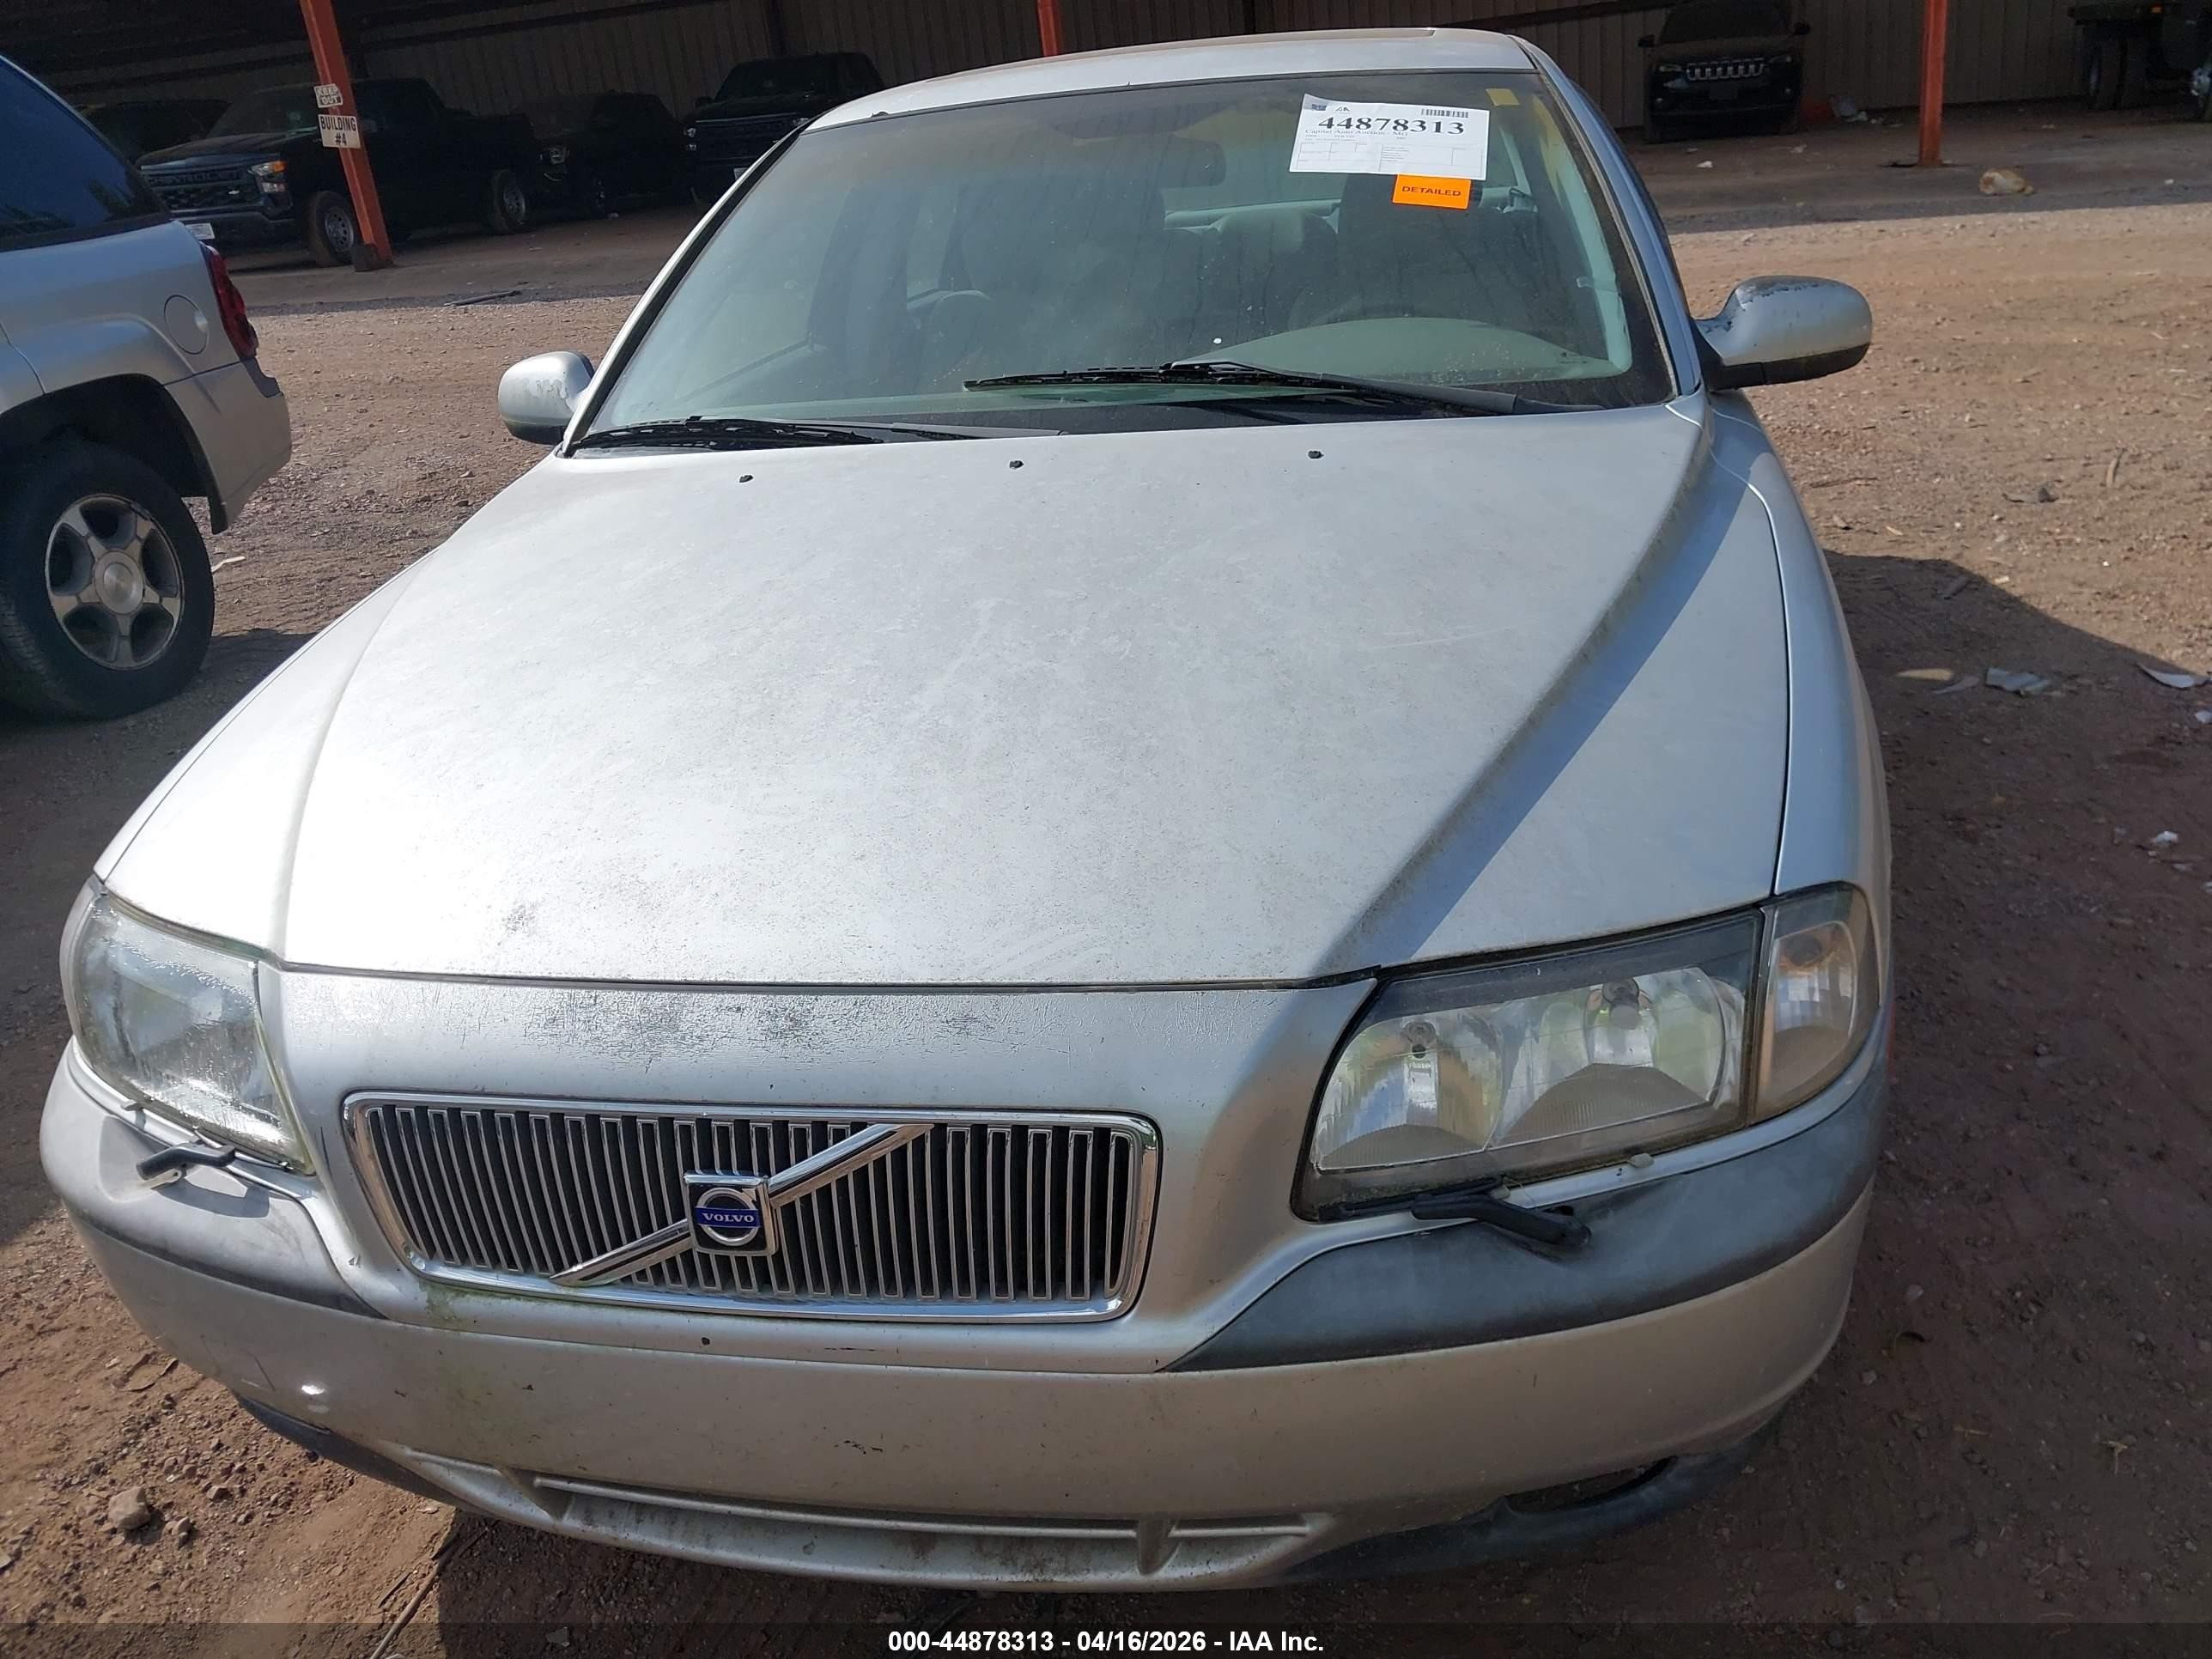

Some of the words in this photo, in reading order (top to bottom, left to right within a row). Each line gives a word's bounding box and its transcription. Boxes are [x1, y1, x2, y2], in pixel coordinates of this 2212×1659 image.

[320, 94, 338, 105] OUT
[319, 116, 356, 131] BUILDING
[1318, 116, 1465, 135] 44878313
[334, 132, 347, 146] #4
[1401, 185, 1462, 197] DETAILED
[702, 1212, 755, 1223] VOLVO
